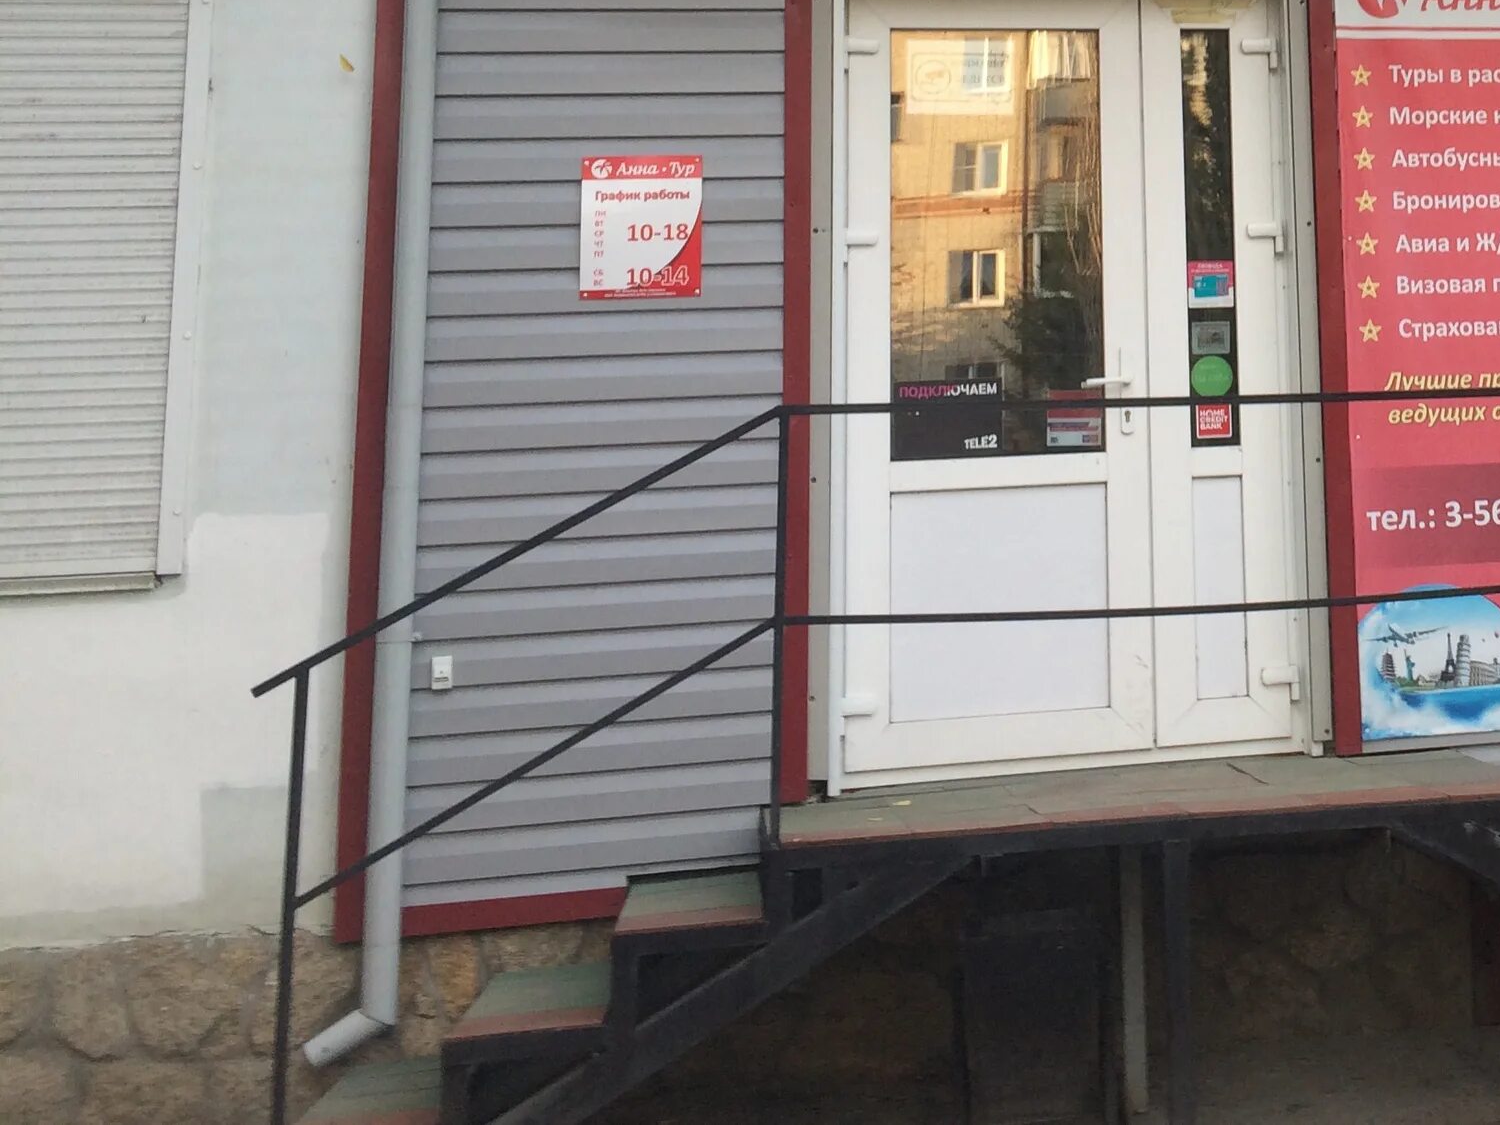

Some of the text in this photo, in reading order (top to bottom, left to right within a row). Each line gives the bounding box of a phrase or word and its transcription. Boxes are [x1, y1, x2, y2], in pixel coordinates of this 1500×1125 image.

[1389, 64, 1444, 87] Туры
[1450, 69, 1462, 84] в
[1390, 106, 1488, 129] Морские
[616, 161, 696, 178] Анна Тур
[595, 189, 690, 203] График работы
[627, 223, 689, 242] 10-18
[1395, 233, 1450, 254] Авиа
[1456, 236, 1469, 252] и
[626, 265, 689, 287] 10-14
[1396, 275, 1486, 295] Визовая
[1384, 371, 1472, 391] Лучшие
[899, 382, 997, 400] ПОДКЛЮЧАЕМ
[1200, 409, 1225, 417] HOME
[1200, 416, 1228, 424] CREDIT
[1388, 402, 1486, 427] ведущих
[1200, 422, 1222, 430] BANK
[964, 434, 998, 450] TELE2
[1366, 506, 1436, 532] тел.:
